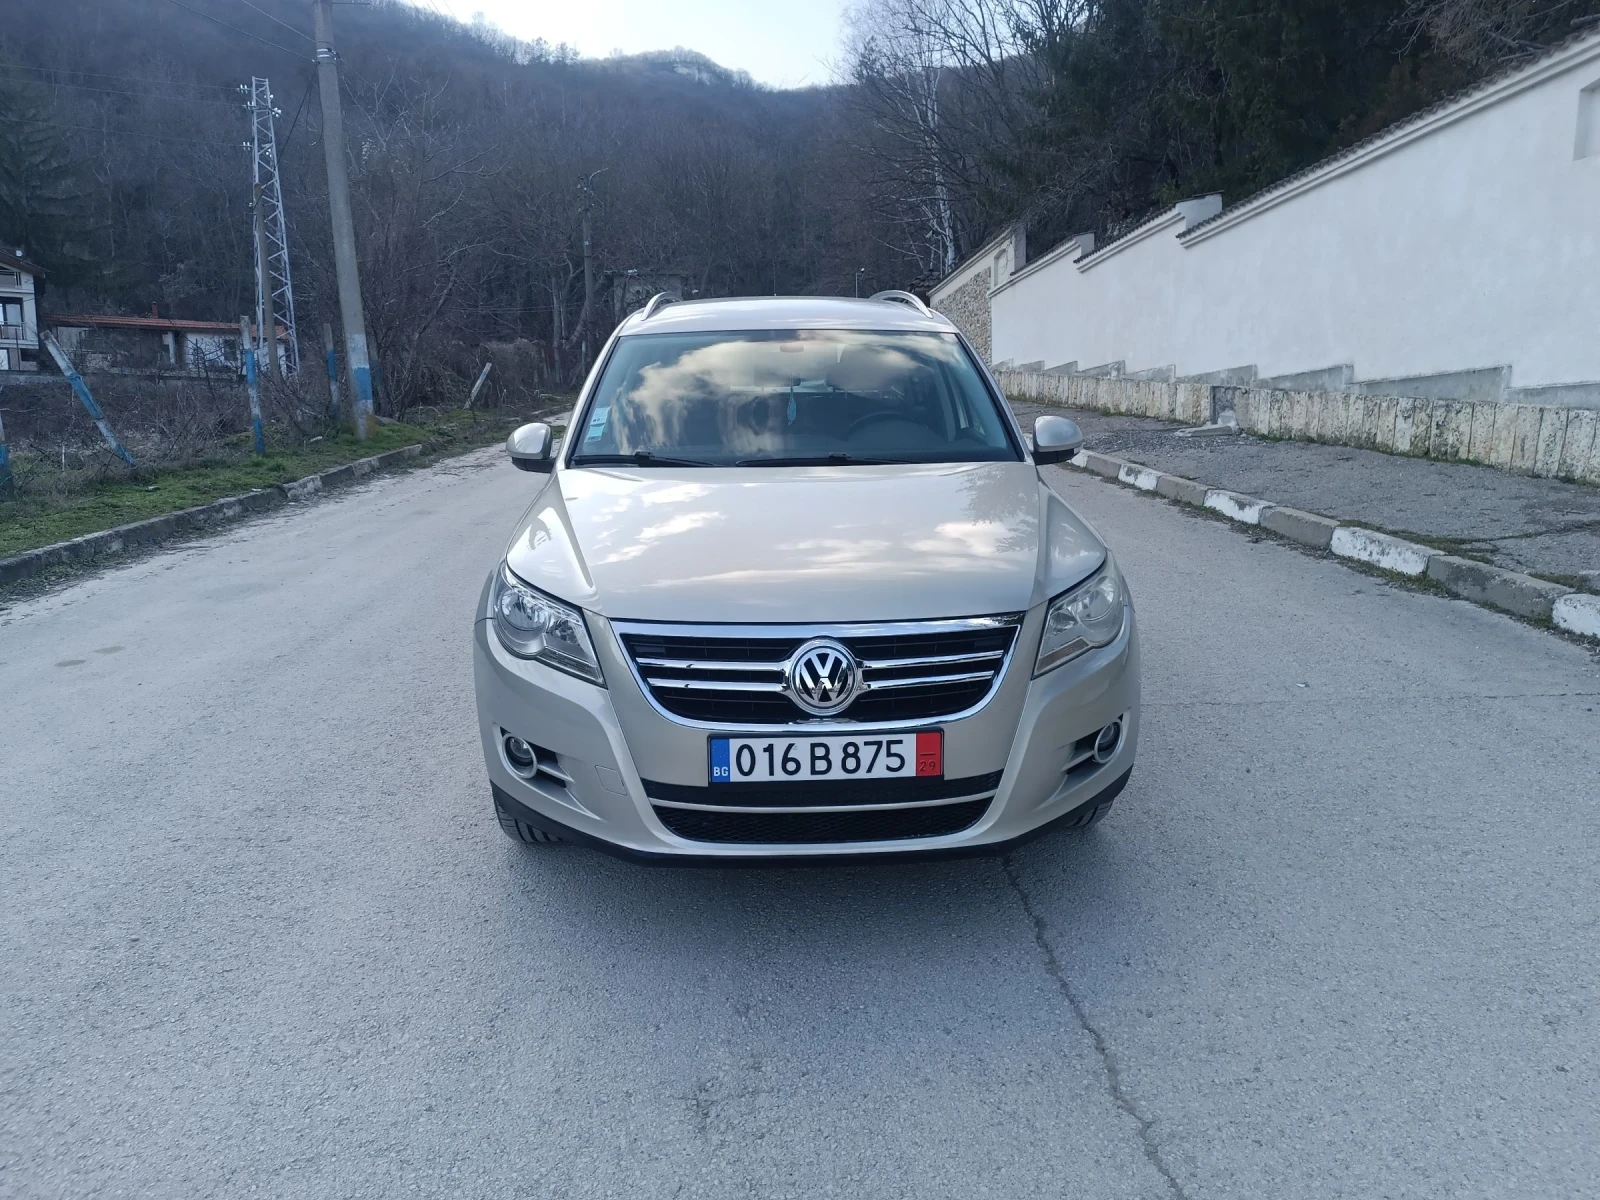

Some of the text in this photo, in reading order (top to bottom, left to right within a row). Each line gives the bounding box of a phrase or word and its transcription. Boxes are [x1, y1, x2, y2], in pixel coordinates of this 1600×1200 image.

[797, 645, 849, 703] VW
[919, 760, 936, 771] 29
[713, 766, 729, 777] BG
